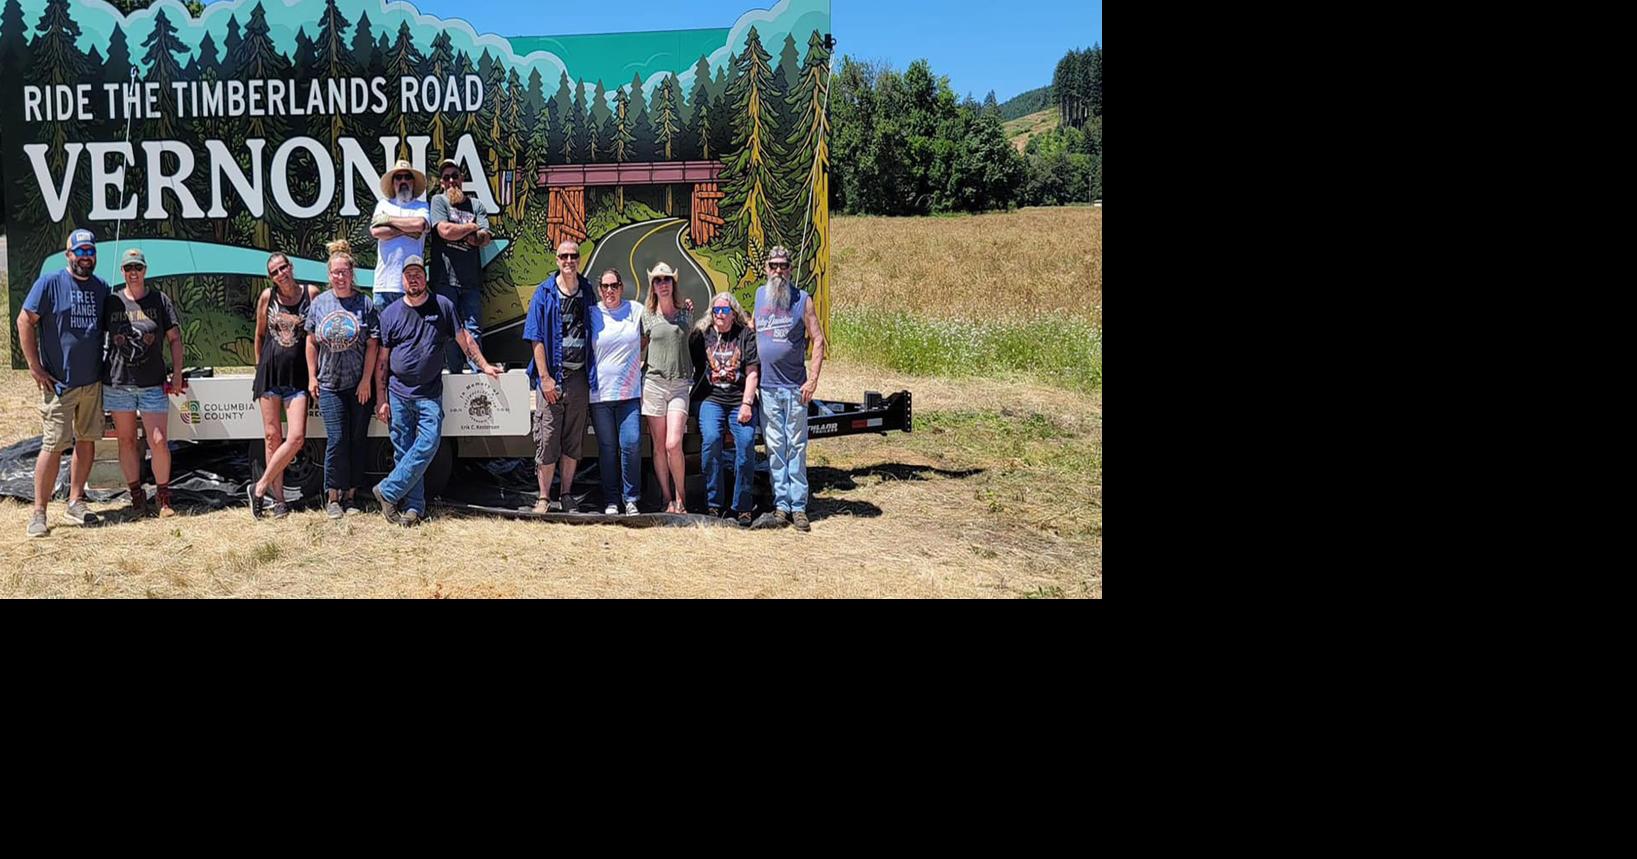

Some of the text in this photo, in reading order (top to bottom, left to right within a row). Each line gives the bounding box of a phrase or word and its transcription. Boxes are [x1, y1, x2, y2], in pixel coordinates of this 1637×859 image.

[24, 74, 484, 121] RIDE THE TIMBERLANDS ROAD
[23, 133, 500, 222] VERNONIA
[70, 290, 96, 304] FREE
[71, 303, 97, 317] RANGE
[204, 403, 255, 412] COLUMBIA
[204, 411, 245, 420] COUNTY
